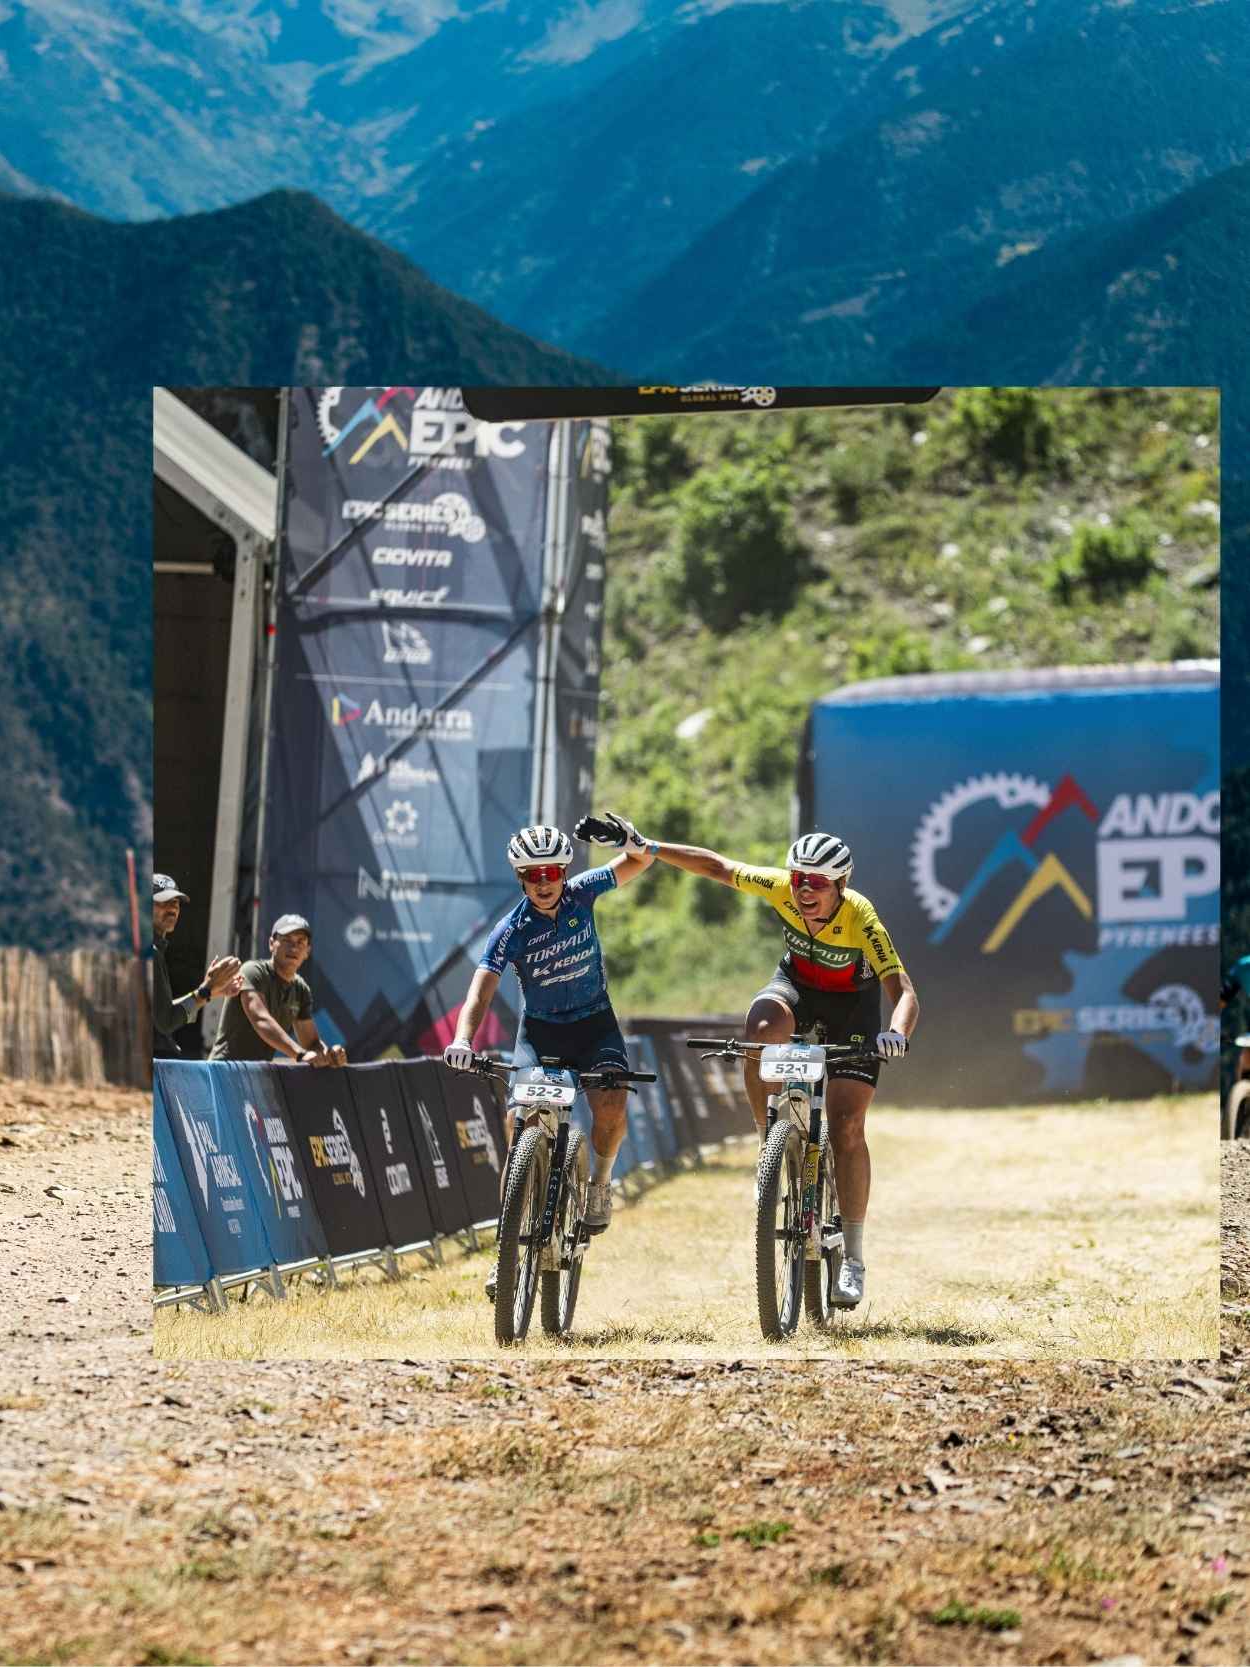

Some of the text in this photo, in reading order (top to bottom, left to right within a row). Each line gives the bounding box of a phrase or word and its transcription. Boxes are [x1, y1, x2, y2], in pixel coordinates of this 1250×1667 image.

[409, 411, 527, 459] EPIC
[525, 920, 592, 964] TORPADO
[553, 945, 597, 971] KENDA
[774, 1062, 809, 1075] 52-1
[525, 1086, 563, 1099] 52-2
